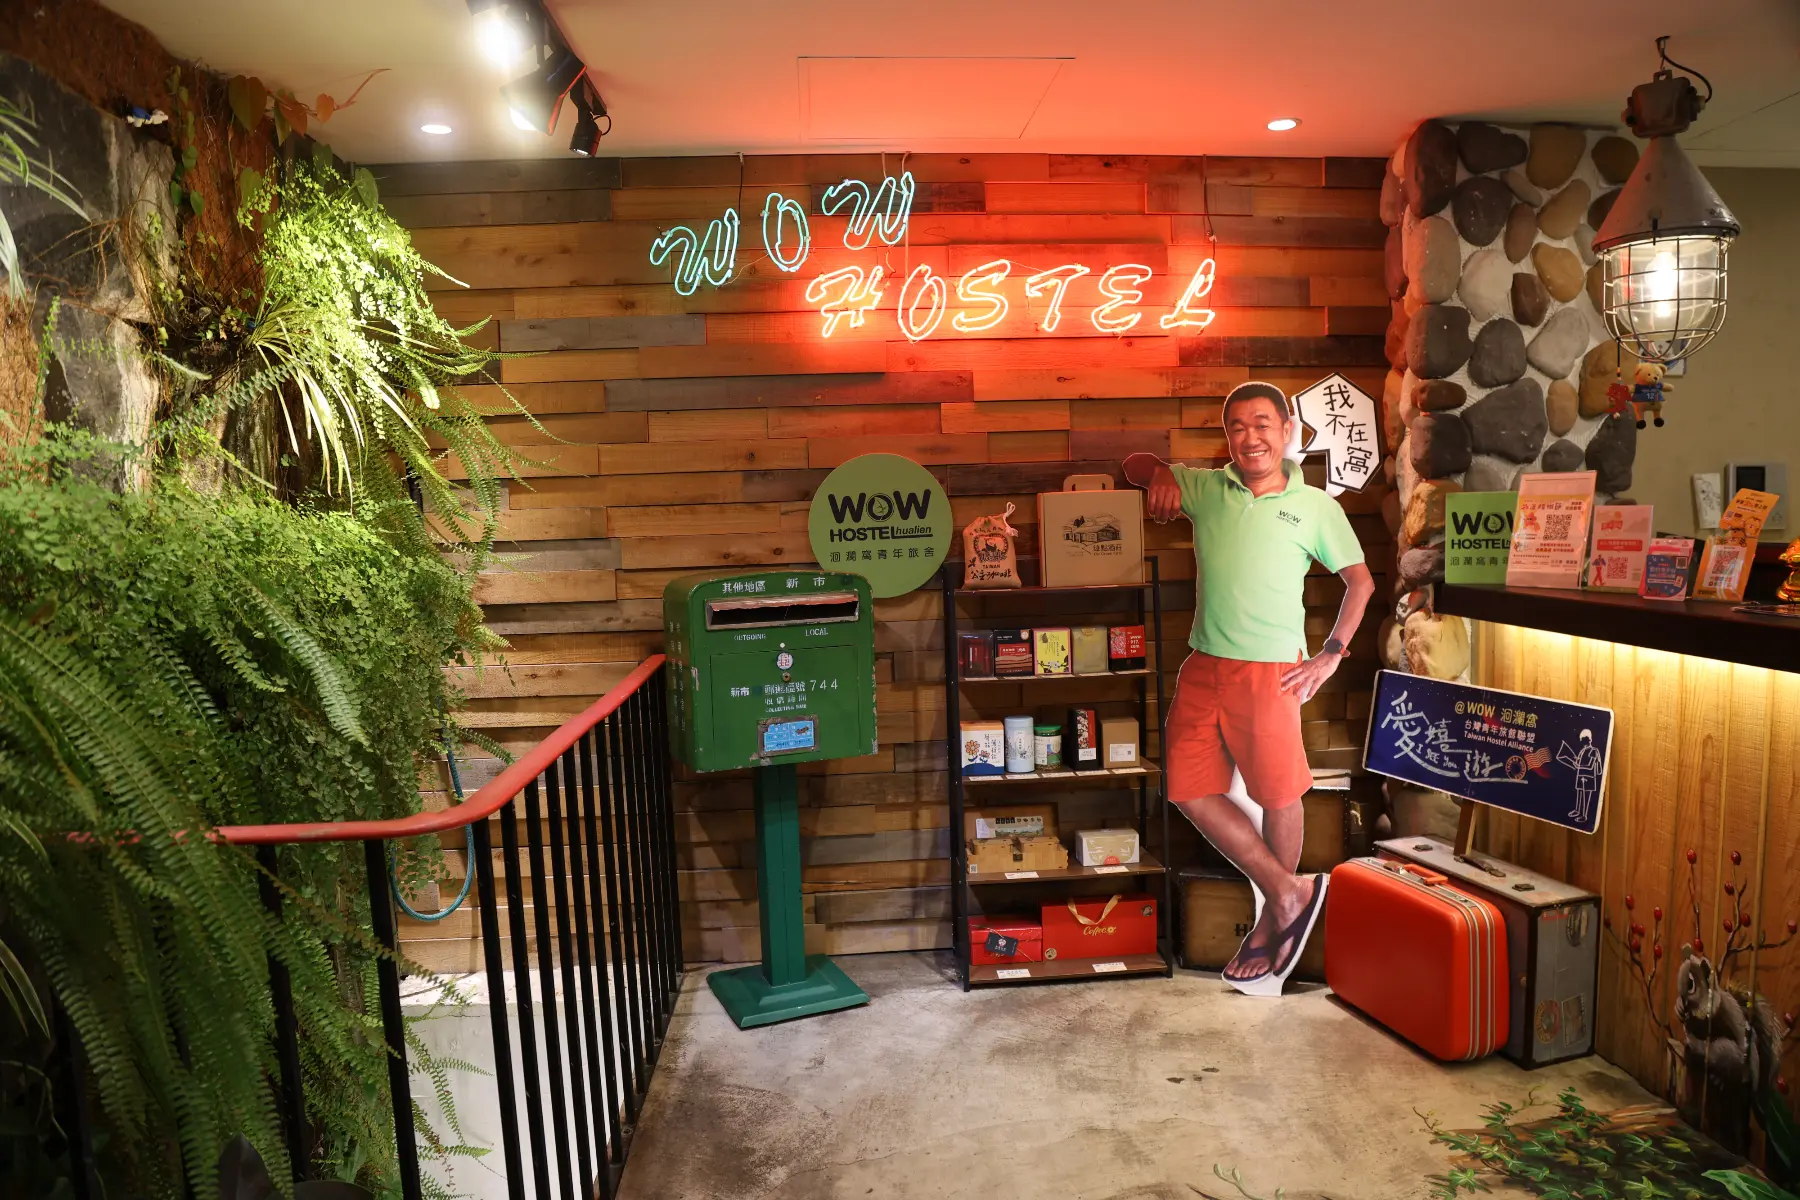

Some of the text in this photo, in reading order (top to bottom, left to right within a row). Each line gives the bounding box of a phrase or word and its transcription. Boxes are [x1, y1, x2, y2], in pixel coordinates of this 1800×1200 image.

[650, 171, 915, 296] WOW
[806, 258, 1216, 341] HOSTEL
[828, 489, 932, 523] WOW
[1279, 509, 1302, 524] WOW
[722, 580, 766, 594] 其他地區
[805, 628, 829, 637] LOCAL
[730, 687, 750, 698] 新市
[1464, 719, 1536, 744] 台灣青年旅館聯盟
[1464, 731, 1534, 753] Taiwan Hostel Alliance
